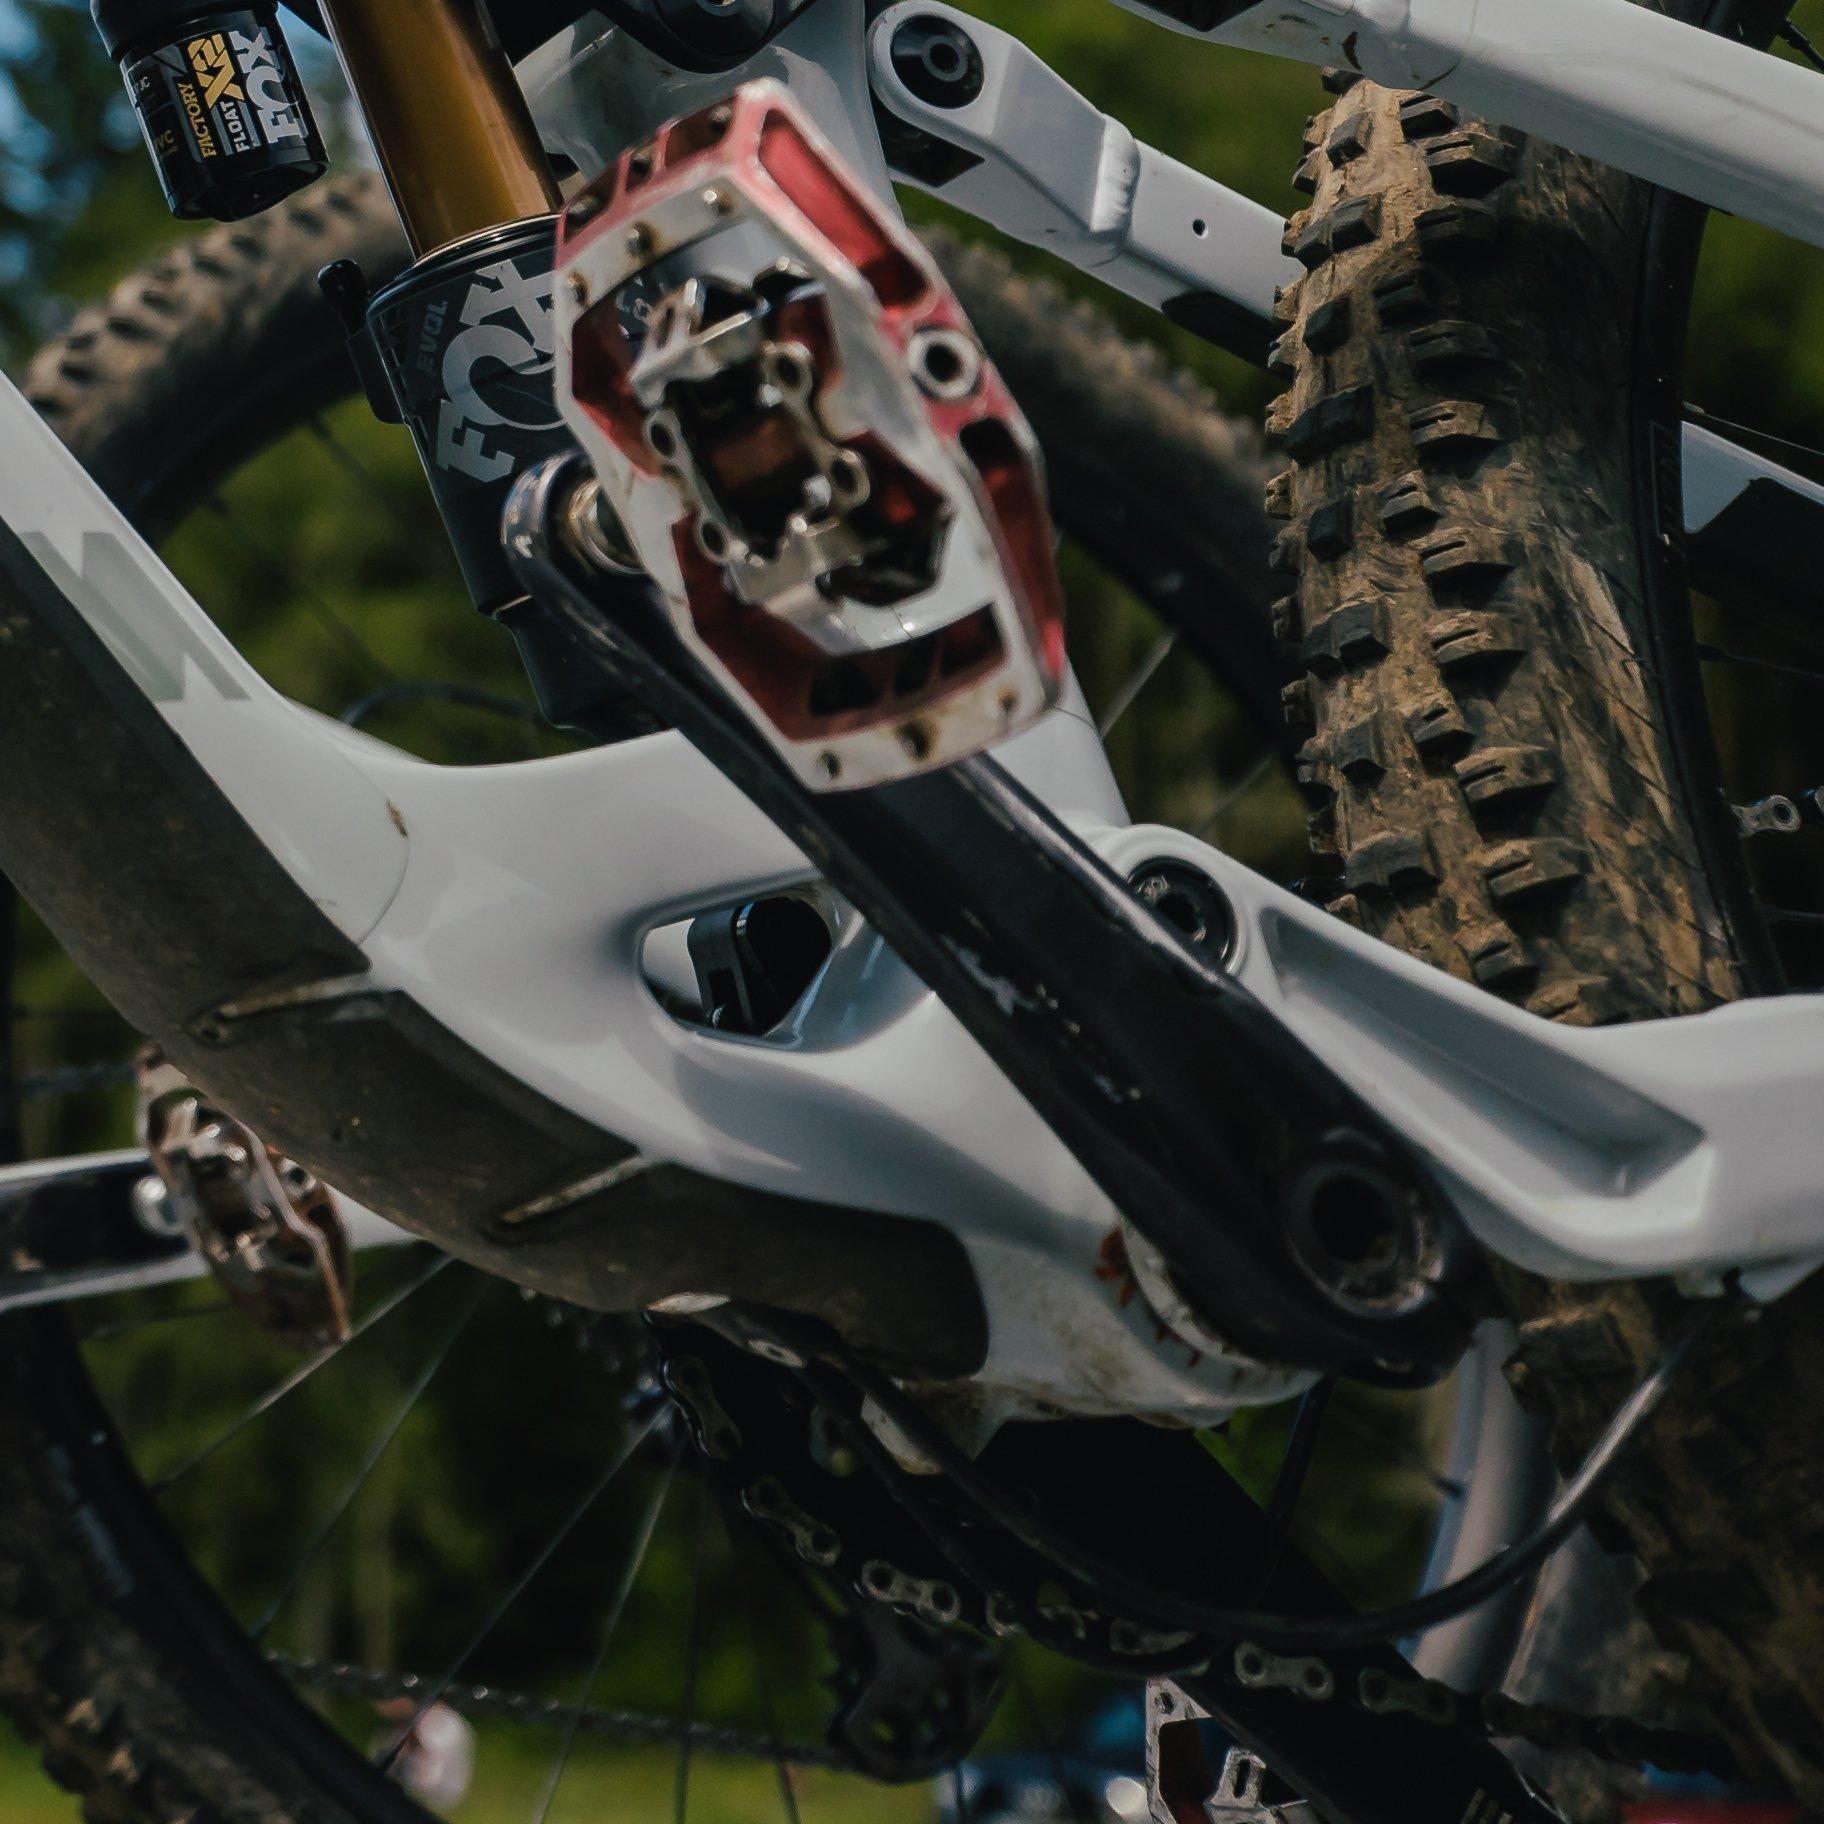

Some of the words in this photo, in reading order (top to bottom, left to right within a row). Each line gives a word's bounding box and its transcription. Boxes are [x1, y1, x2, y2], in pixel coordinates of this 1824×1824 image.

[187, 33, 245, 110] X2
[228, 29, 304, 145] FOX
[177, 82, 217, 159] FACTORY
[220, 100, 250, 154] FLOAT
[417, 299, 449, 375] EVOL
